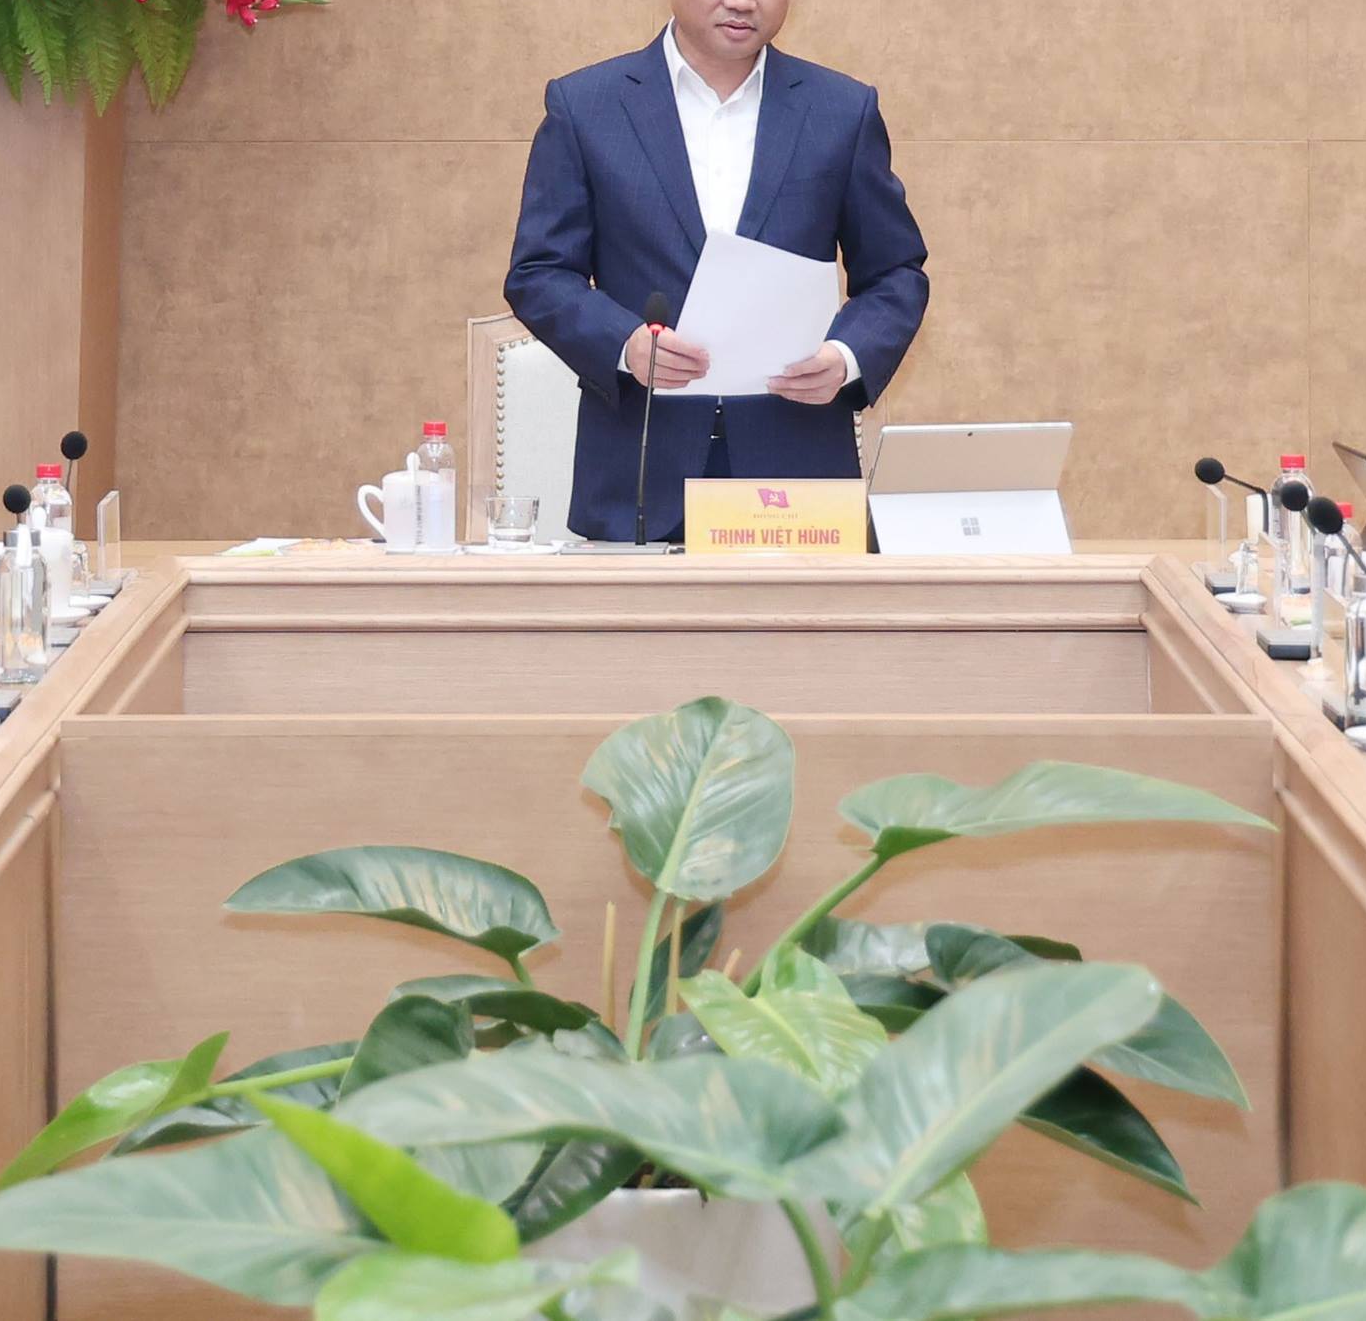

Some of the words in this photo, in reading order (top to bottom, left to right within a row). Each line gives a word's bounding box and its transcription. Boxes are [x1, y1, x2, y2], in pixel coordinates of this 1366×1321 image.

[709, 528, 756, 548] TRỊNH
[761, 525, 793, 548] VIỆT
[797, 525, 841, 546] HÙNG
